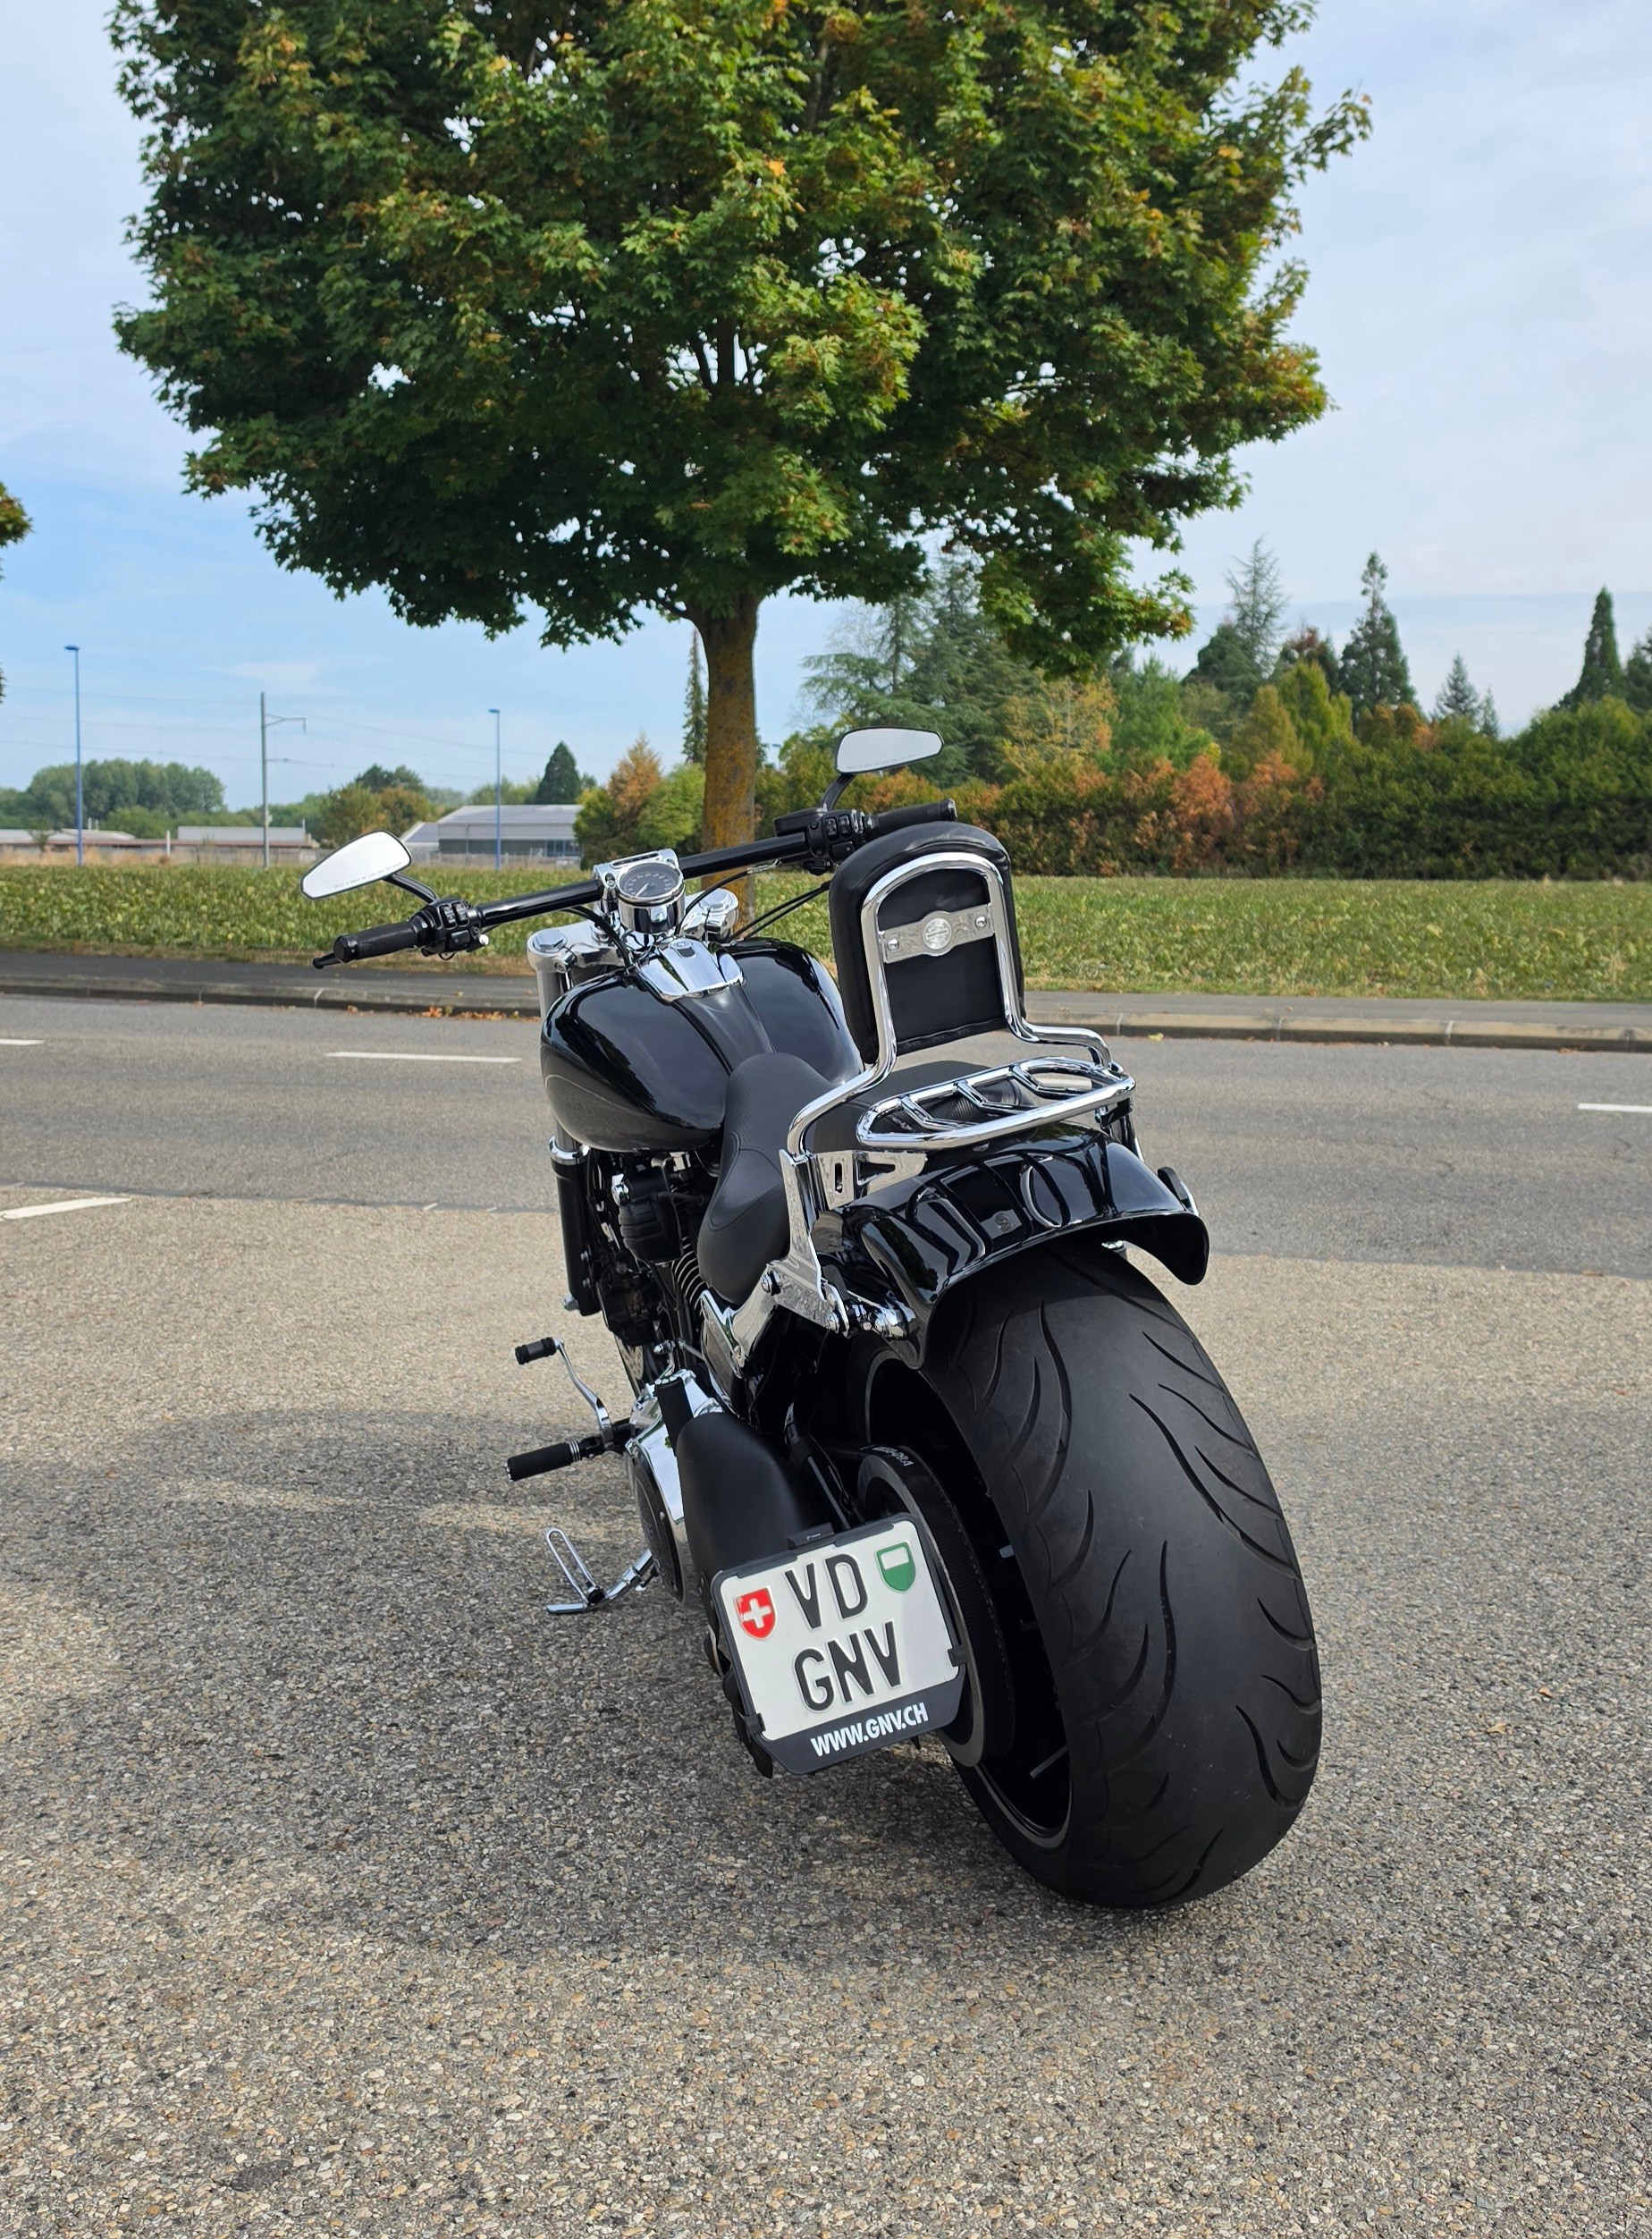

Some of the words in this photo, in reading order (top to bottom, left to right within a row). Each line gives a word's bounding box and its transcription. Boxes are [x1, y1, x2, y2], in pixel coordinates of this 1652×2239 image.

[785, 1554, 868, 1629] VD
[796, 1621, 902, 1711] GNV
[810, 1702, 929, 1757] WWW.GNV.CH
